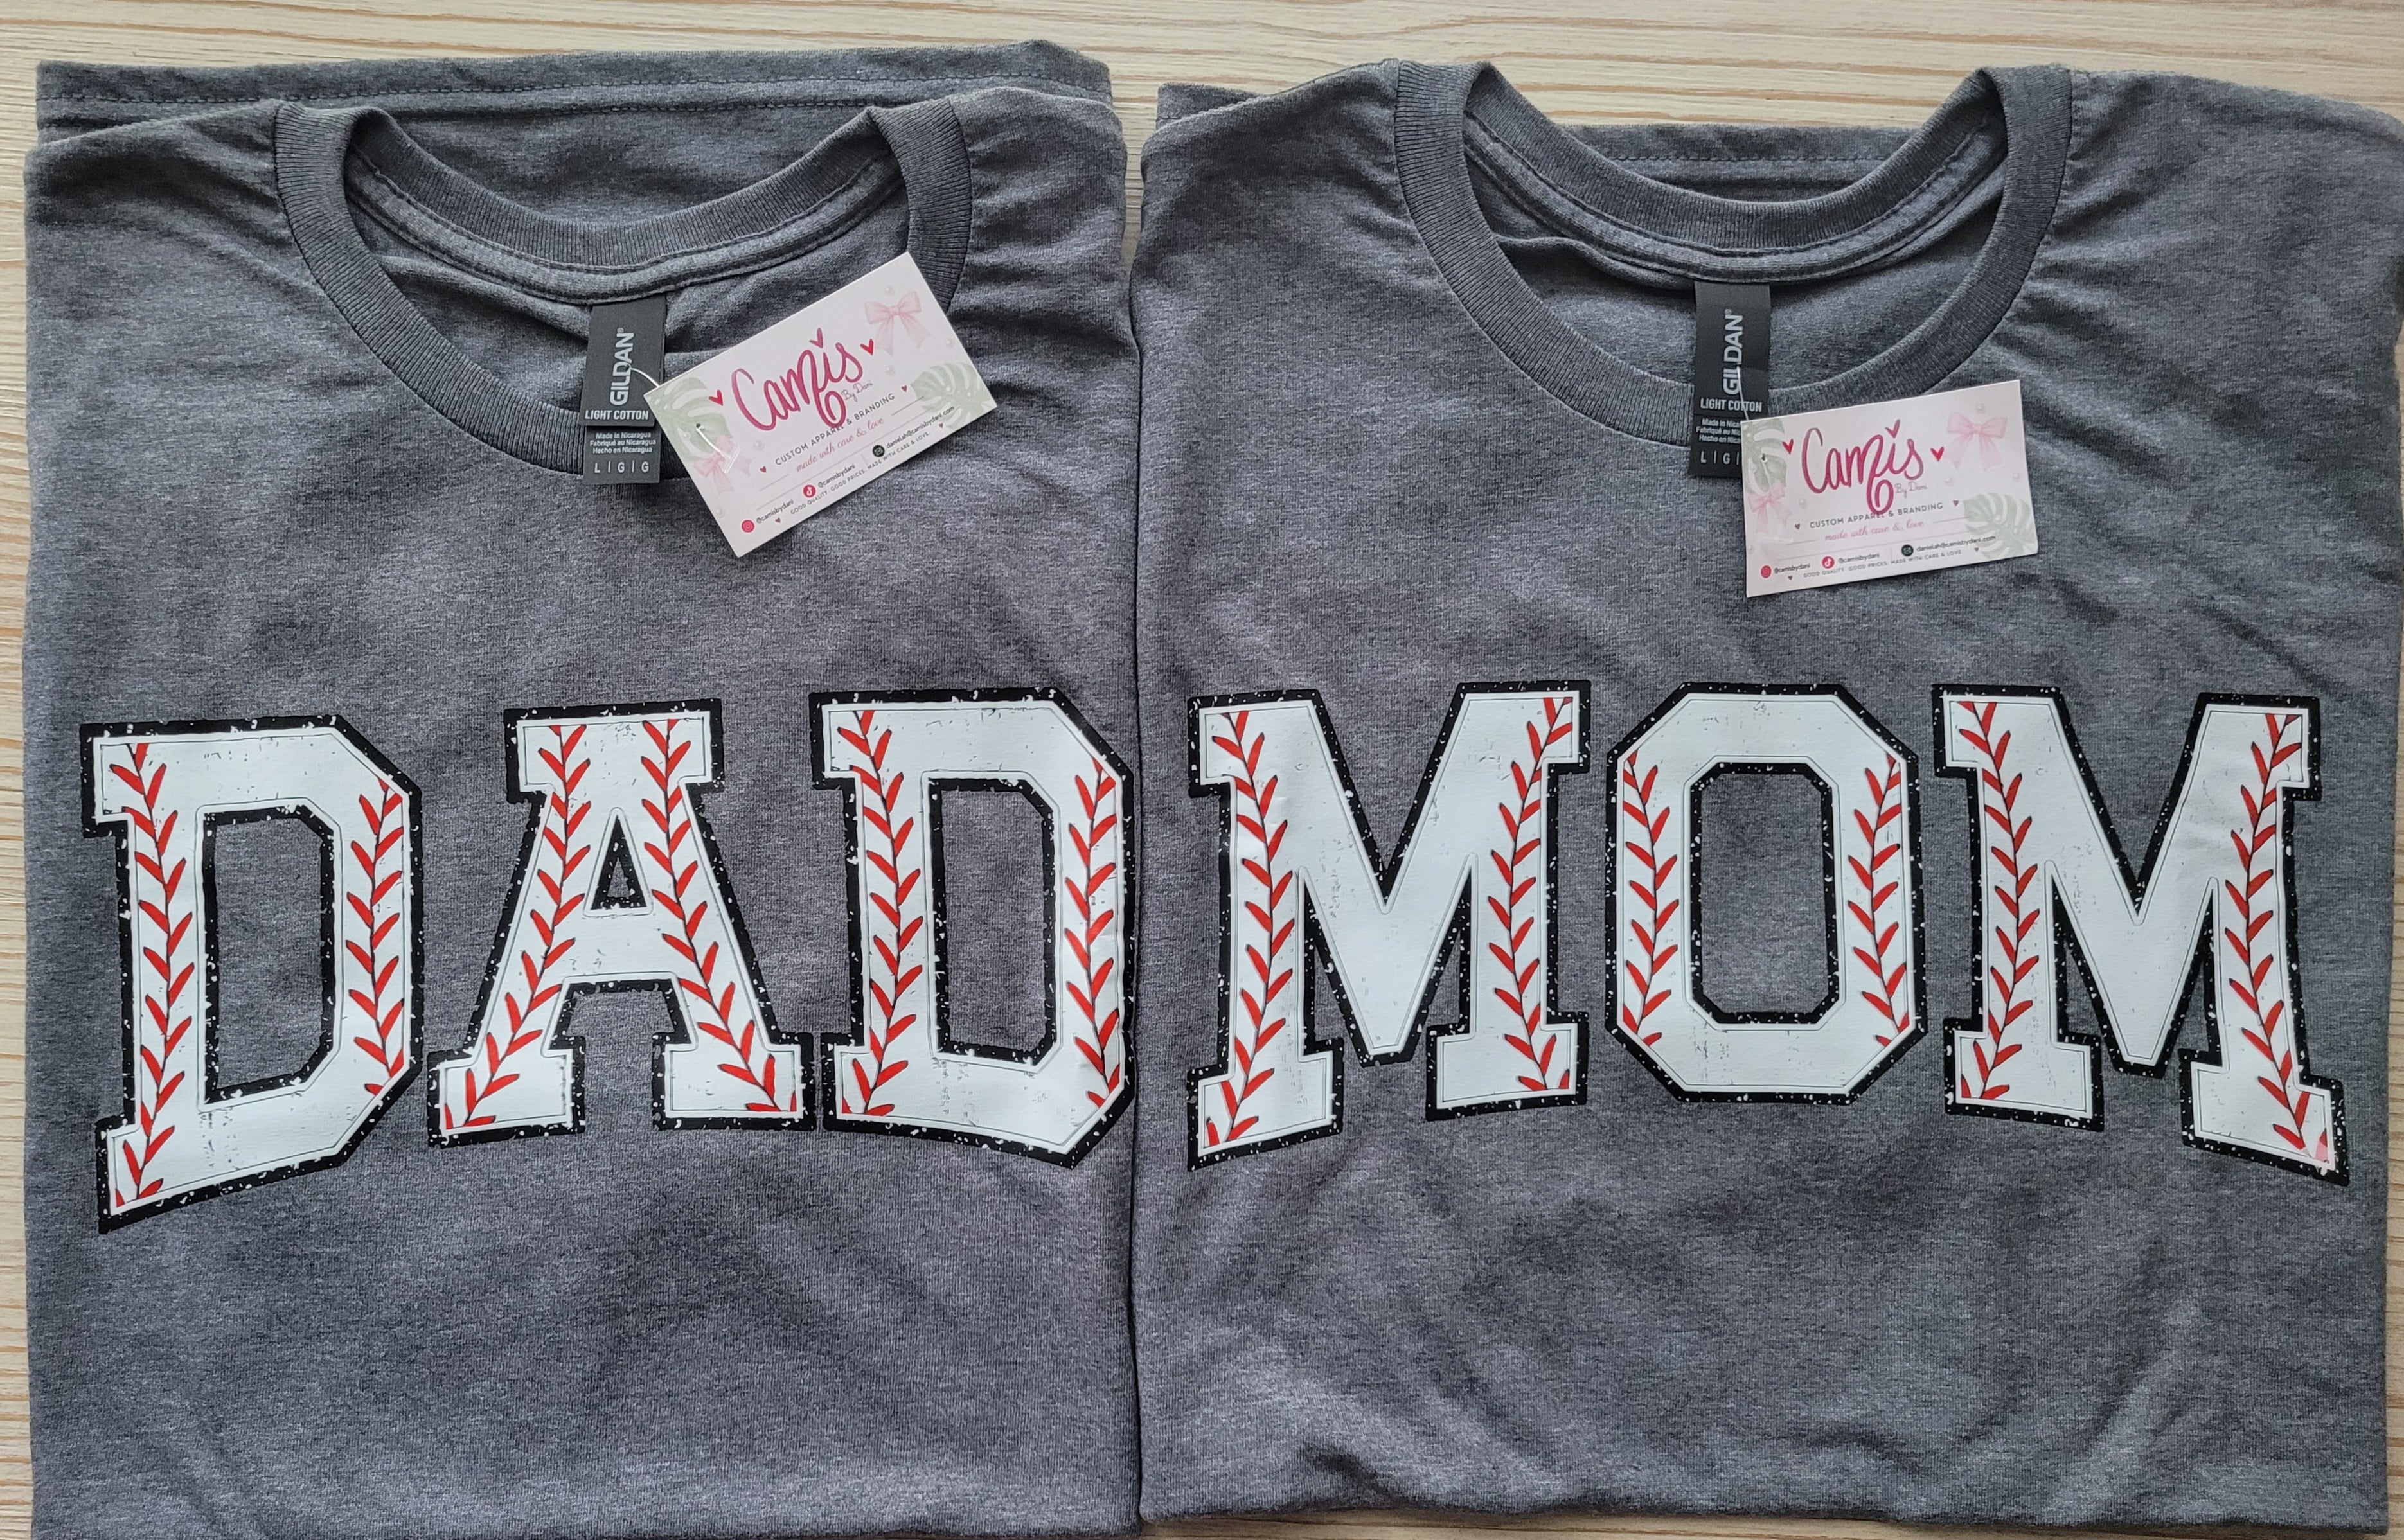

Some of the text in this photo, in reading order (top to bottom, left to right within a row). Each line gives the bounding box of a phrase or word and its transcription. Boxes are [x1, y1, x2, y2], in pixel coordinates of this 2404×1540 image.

[731, 328, 863, 430] Camis
[841, 389, 858, 402] By
[1700, 397, 1763, 412] LIGHT COTTON
[585, 409, 649, 420] LIGHT COTTON
[1702, 418, 1719, 426] Made
[775, 443, 808, 466] CUSTOM
[811, 423, 844, 446] APPAREL
[854, 393, 895, 421] BRANDING
[1699, 434, 1718, 442] Hecho
[796, 417, 884, 473] made with care & love
[1700, 450, 1707, 463] L
[1723, 452, 1731, 464] G
[594, 462, 600, 473] L
[618, 461, 625, 473] G
[641, 461, 649, 473] G
[790, 503, 806, 515] GOOD
[830, 479, 846, 491] GOOD
[867, 459, 882, 470] MADE
[883, 451, 896, 461] WITH
[896, 443, 910, 453] CARE
[817, 463, 856, 488] @camisbydani
[1802, 419, 1924, 515] Camis
[756, 499, 794, 524] @camisbydani
[1810, 517, 1844, 528] CUSTOM
[1848, 511, 1885, 522] APPAREL
[1898, 502, 1943, 515] BRANDING
[1824, 518, 1924, 541] made with care & love
[1187, 680, 2351, 1187] MOM
[80, 687, 1136, 1234] DAD
